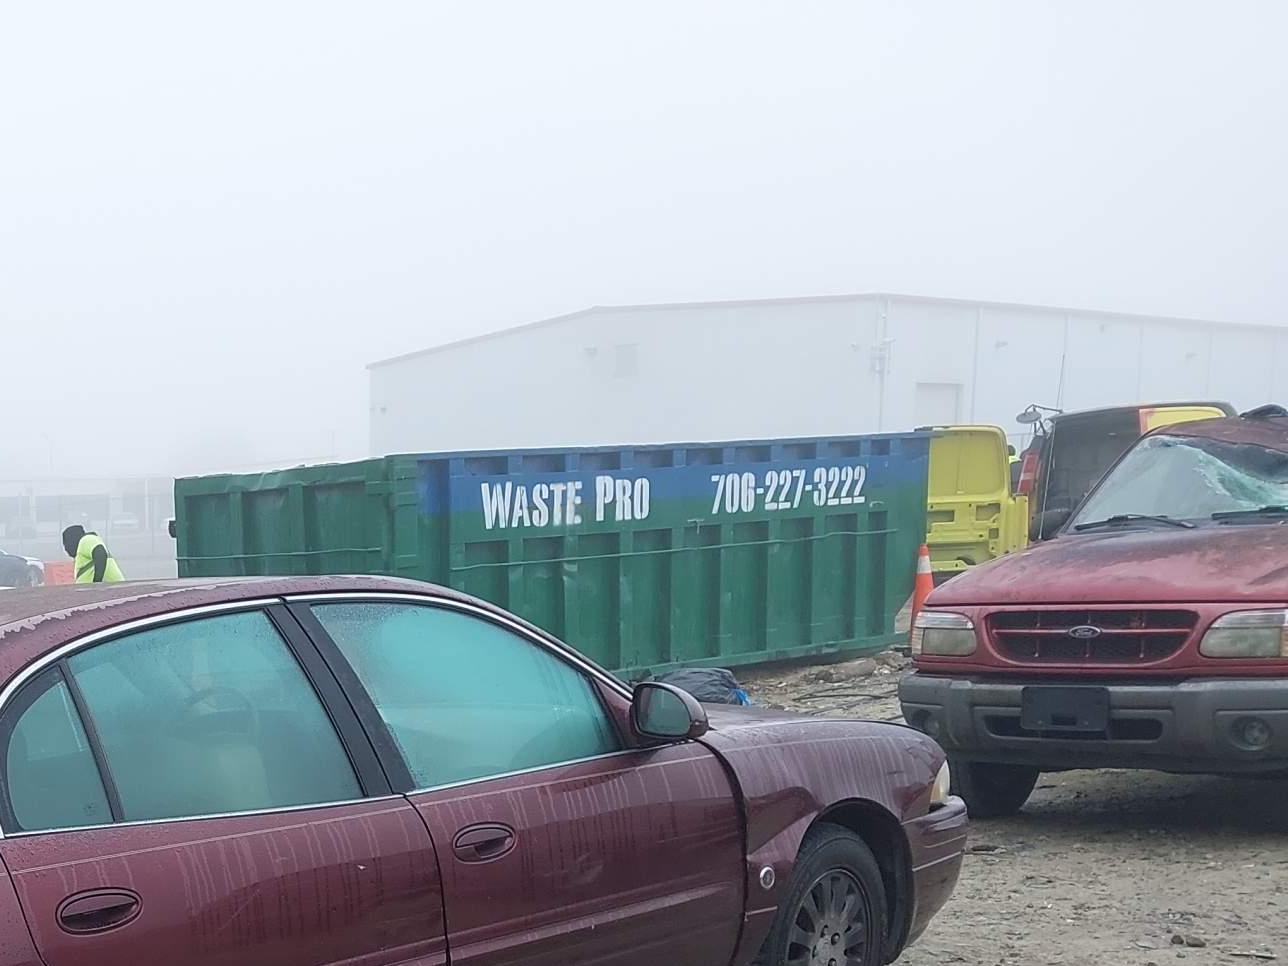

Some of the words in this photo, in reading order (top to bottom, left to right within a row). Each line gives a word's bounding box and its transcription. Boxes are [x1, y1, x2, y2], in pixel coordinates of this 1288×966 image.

[480, 480, 583, 529] WASTE
[595, 475, 651, 521] PRO
[711, 464, 867, 515] 706-227-3222
